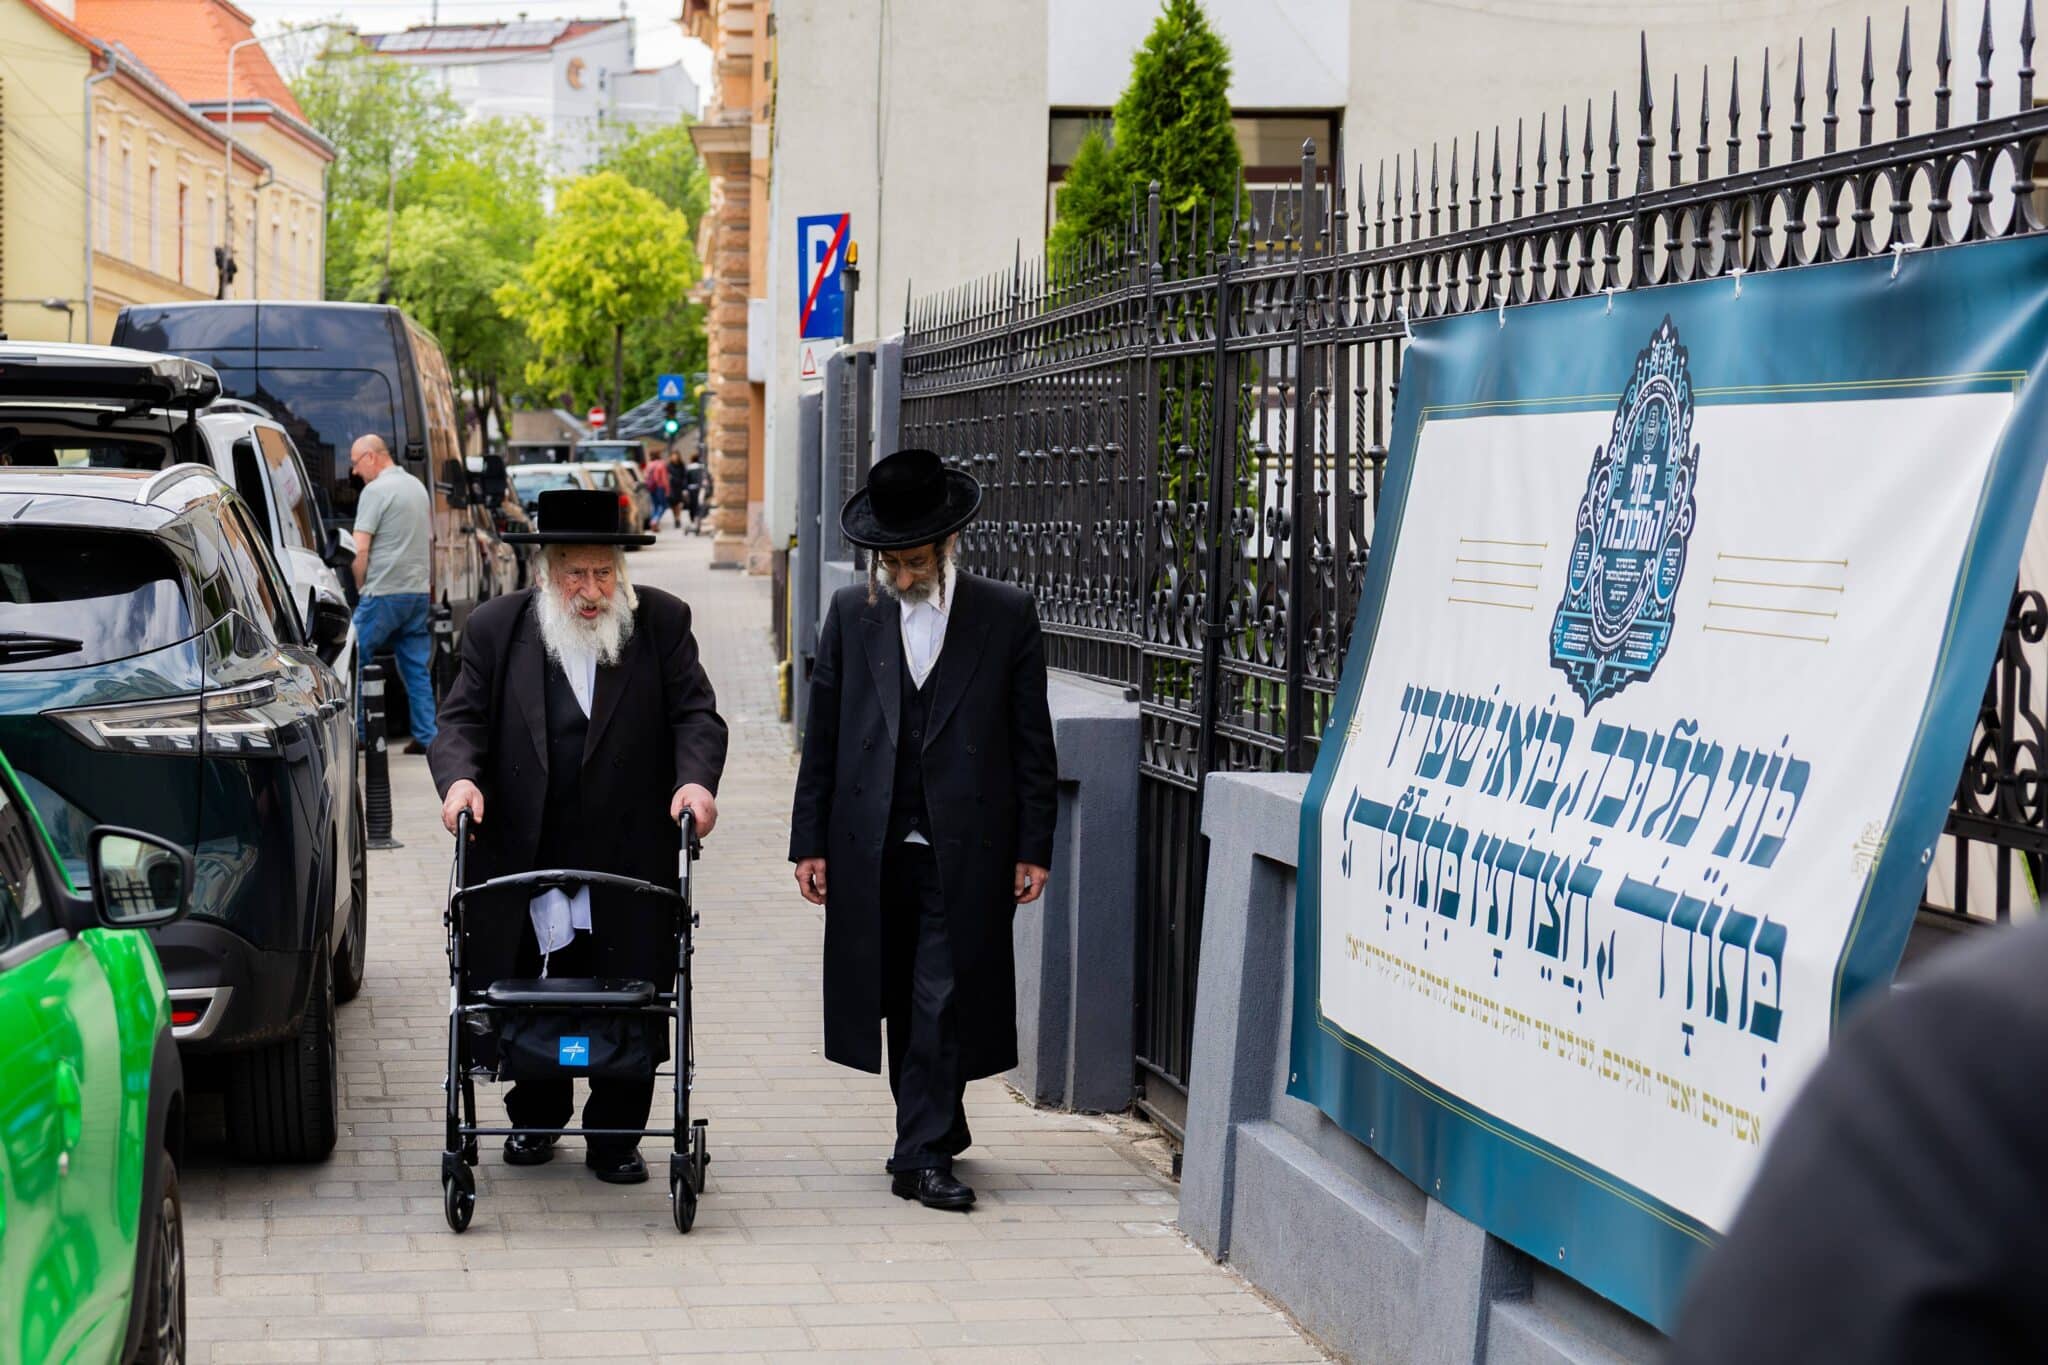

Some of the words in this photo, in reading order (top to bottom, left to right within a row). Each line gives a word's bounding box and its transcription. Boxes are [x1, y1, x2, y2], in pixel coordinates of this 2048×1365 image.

[807, 224, 838, 312] P
[1656, 1072, 1697, 1118] ואשרי
[1702, 1092, 1761, 1148] אשריכם
